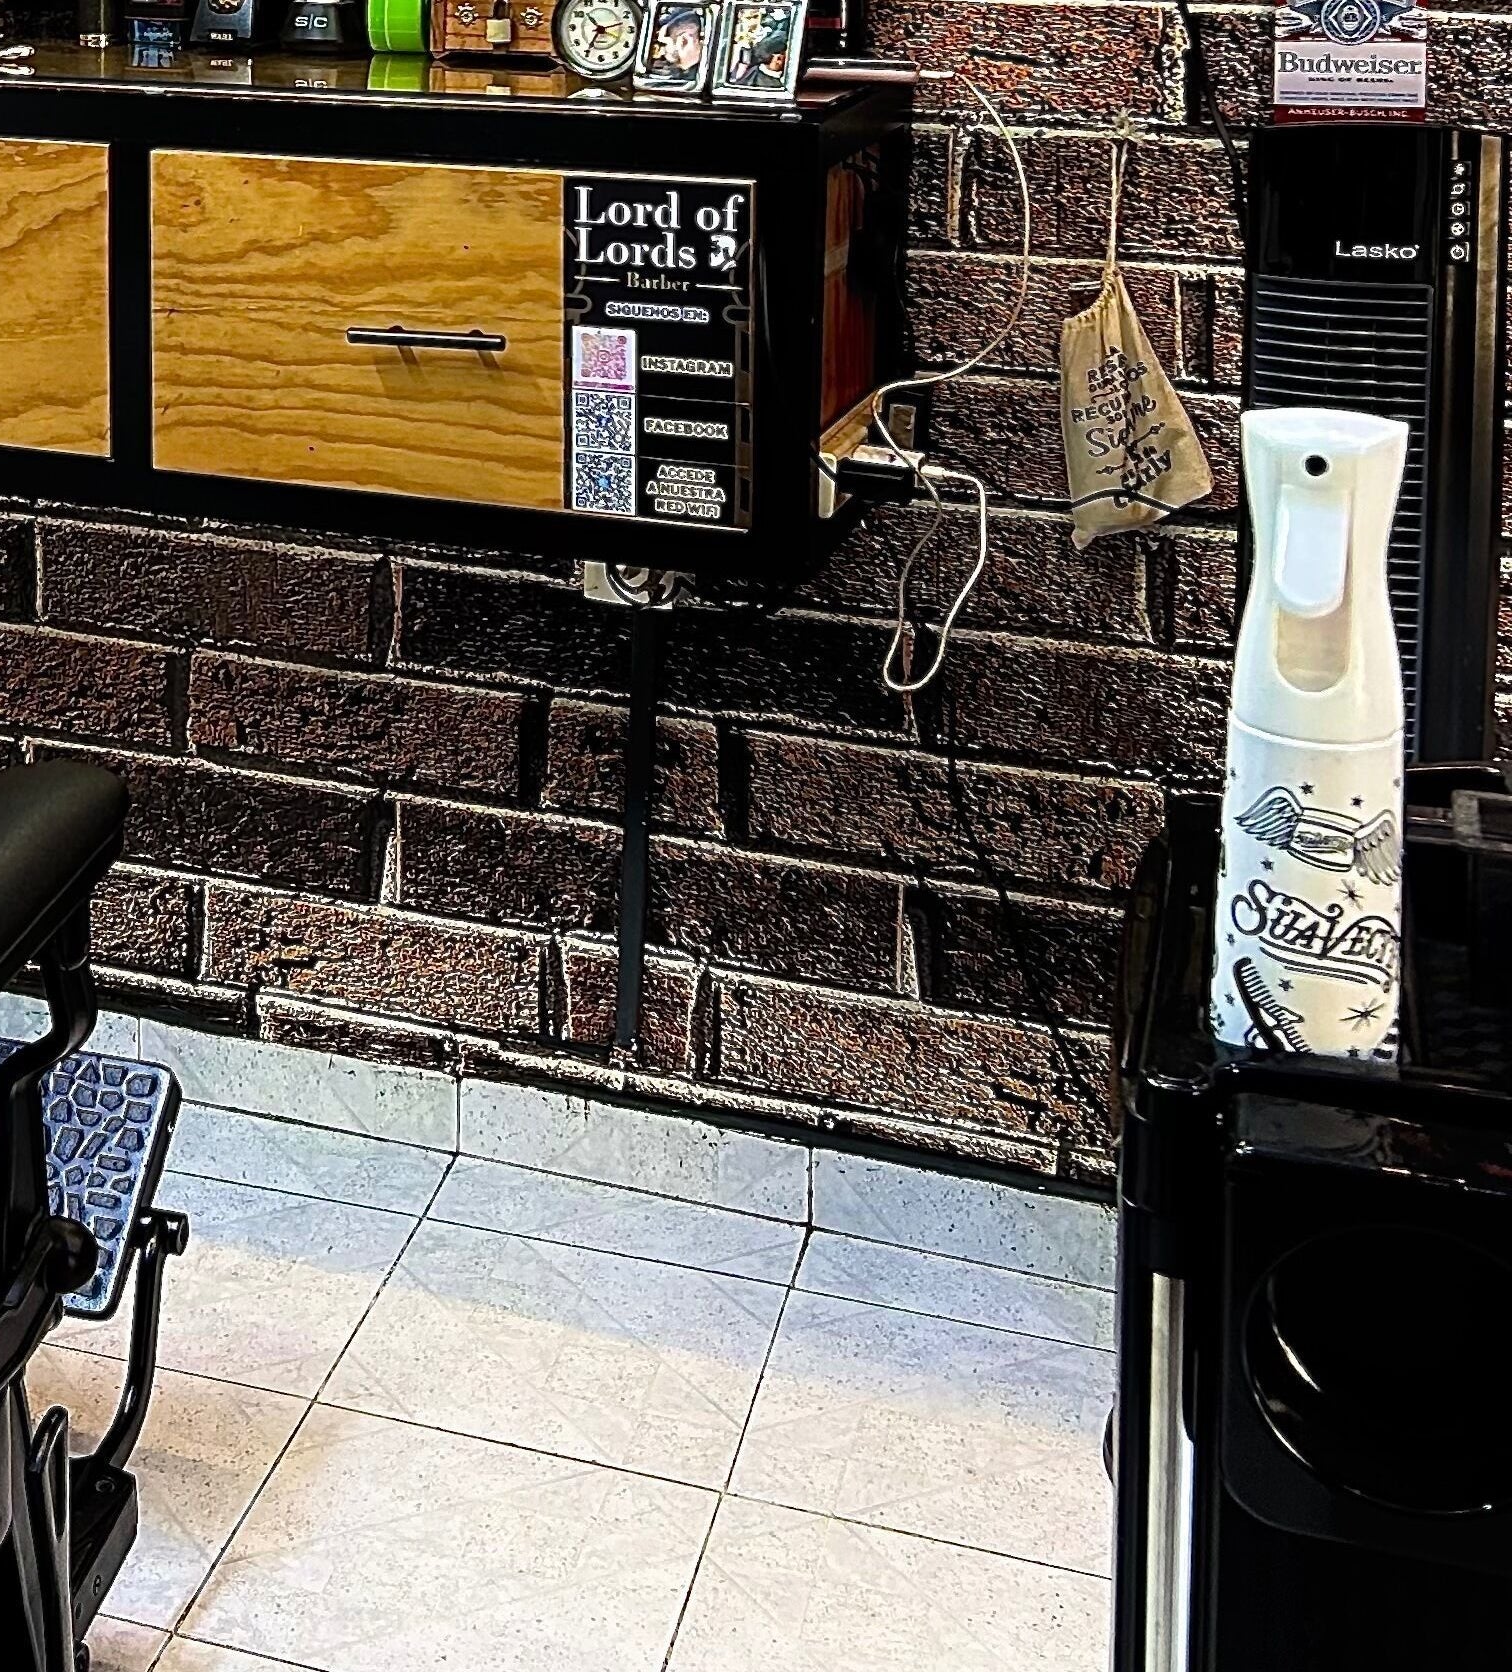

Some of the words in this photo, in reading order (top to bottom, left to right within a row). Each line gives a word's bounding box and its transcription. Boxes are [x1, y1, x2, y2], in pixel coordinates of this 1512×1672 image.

[1277, 51, 1422, 75] Budweiser
[574, 186, 681, 229] Lord
[696, 194, 745, 232] of
[574, 226, 697, 269] Lords
[1335, 240, 1417, 259] Lasko
[626, 271, 691, 292] Barber
[682, 308, 709, 322] EN:
[641, 355, 733, 377] INSTAGRAM
[644, 417, 728, 439] FACEBOOK
[657, 465, 715, 483] ACCEDE
[646, 481, 660, 495] A
[660, 482, 726, 502] NUESTRA
[655, 499, 686, 514] RED
[686, 502, 721, 519] WIFI
